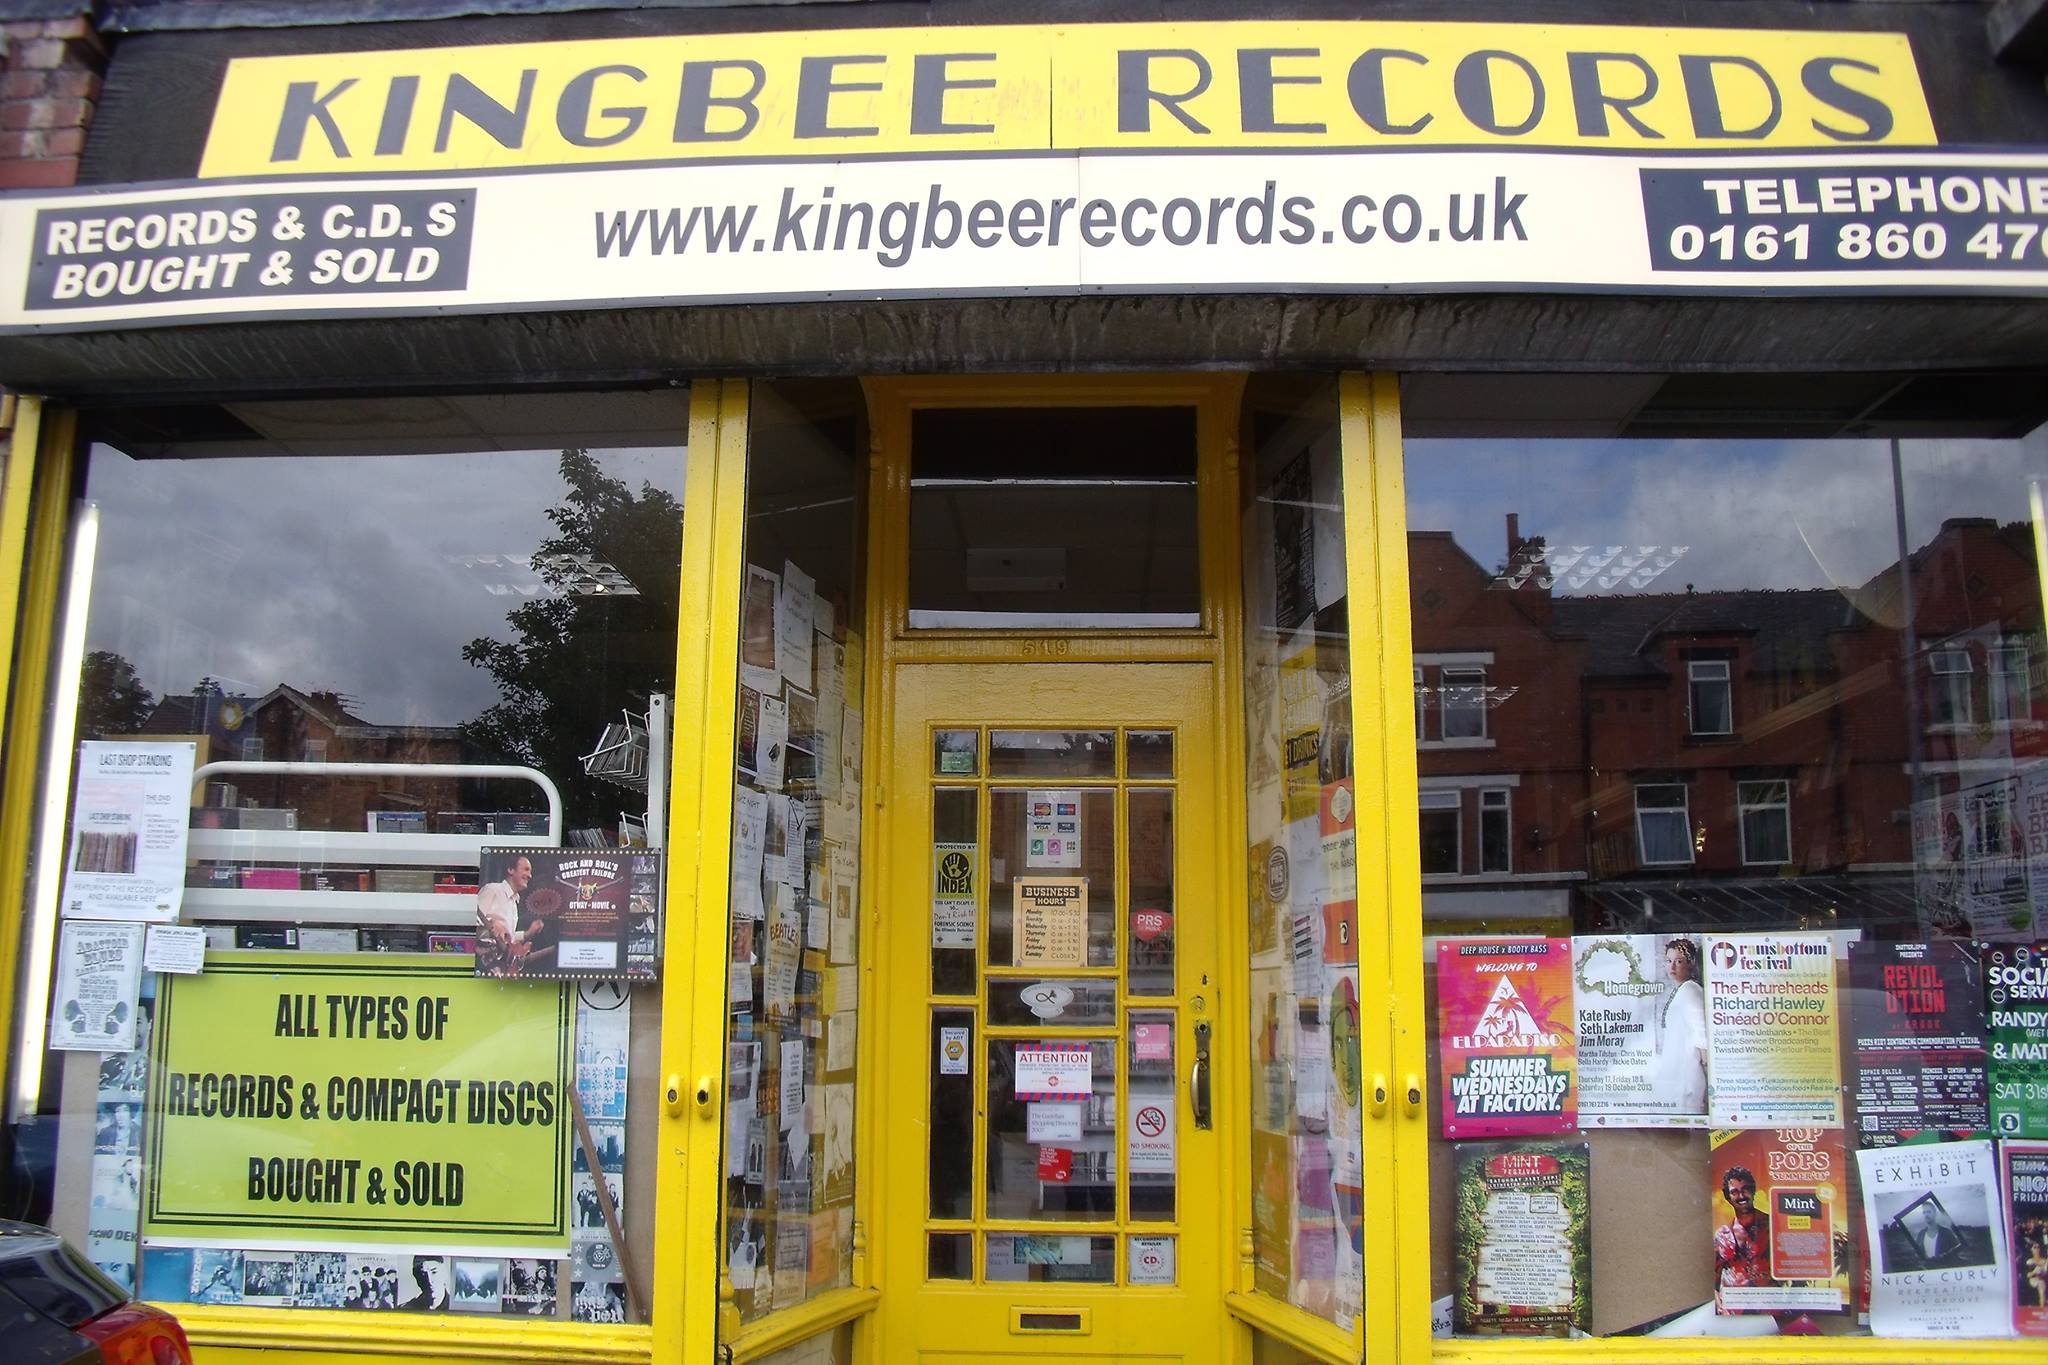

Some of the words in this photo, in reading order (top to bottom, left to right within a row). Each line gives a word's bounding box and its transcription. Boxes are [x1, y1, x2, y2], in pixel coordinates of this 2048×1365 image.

[270, 53, 996, 163] KINGBEE
[1117, 48, 1894, 142] RECORDS
[1703, 176, 2048, 214] TELEPHONE
[594, 176, 1528, 267] www.kingbeerecords.co.uk
[47, 207, 257, 256] RECORDS
[273, 206, 306, 242] &
[322, 204, 413, 241] C.D.
[427, 203, 457, 238] S
[1669, 224, 1809, 260] 0161
[1838, 222, 1946, 260] 860
[1966, 222, 2048, 260] 47
[52, 252, 249, 300] BOUGHT
[260, 250, 294, 288] &
[310, 247, 441, 285] SOLD
[99, 754, 117, 766] LAST
[118, 754, 137, 766] SHOP
[138, 755, 172, 767] STANDING
[559, 860, 579, 871] ROCK
[579, 859, 594, 868] AND
[595, 860, 619, 872] ROLL'S
[561, 868, 590, 880] GREATEST
[937, 869, 972, 893] INDEX
[1025, 887, 1075, 897] BUSINESS
[569, 901, 588, 910] OTWAY
[1137, 914, 1162, 926] PRS
[1461, 945, 1476, 955] DEEP
[1478, 945, 1499, 954] HOUSE
[1508, 945, 1529, 953] BOOTY
[1530, 944, 1547, 953] BASS
[1740, 942, 1827, 955] ramsbottom
[1476, 963, 1524, 973] WELCOME
[1526, 962, 1538, 972] TO
[1740, 956, 1792, 970] festival
[1884, 965, 1944, 988] REVOL
[1604, 981, 1664, 995] Homegrown
[1712, 981, 1738, 994] The
[1741, 981, 1829, 994] Futureheads
[1713, 997, 1769, 1010] Richard
[1773, 997, 1825, 1012] Hawley
[275, 994, 319, 1038] ALL
[327, 995, 409, 1040] TYPES
[415, 998, 449, 1041] OF
[1579, 1010, 1602, 1021] Kate
[1604, 1009, 1632, 1022] Rusby
[1713, 1012, 1761, 1026] Sinéad
[1764, 1012, 1830, 1026] O'Connor
[1992, 1011, 2048, 1027] RANDY
[1580, 1023, 1602, 1034] Seth
[1604, 1023, 1644, 1034] Lakeman
[1579, 1036, 1595, 1047] Jim
[1597, 1035, 1625, 1047] Moray
[1769, 1038, 1819, 1046] Broadcasting
[1993, 1042, 2007, 1059] &
[1020, 1053, 1088, 1063] ATTENTION
[1470, 1058, 1547, 1077] SUMMER
[1453, 1075, 1567, 1095] WEDNESDAYS
[1995, 1083, 2021, 1099] SAT
[2026, 1083, 2048, 1099] 31s
[169, 1073, 294, 1120] RECORDS
[301, 1083, 320, 1121] &
[327, 1076, 461, 1124] COMPACT
[468, 1080, 554, 1126] DISCS
[1457, 1095, 1480, 1113] AT
[1483, 1093, 1561, 1112] FACTORY.
[1776, 1129, 1823, 1142] TOP
[1769, 1152, 1830, 1170] POPS
[248, 1157, 360, 1203] BOUGHT
[367, 1167, 387, 1204] &
[394, 1161, 464, 1207] SOLD
[1784, 1198, 1815, 1210] Mint
[1941, 1268, 1998, 1282] CURLY
